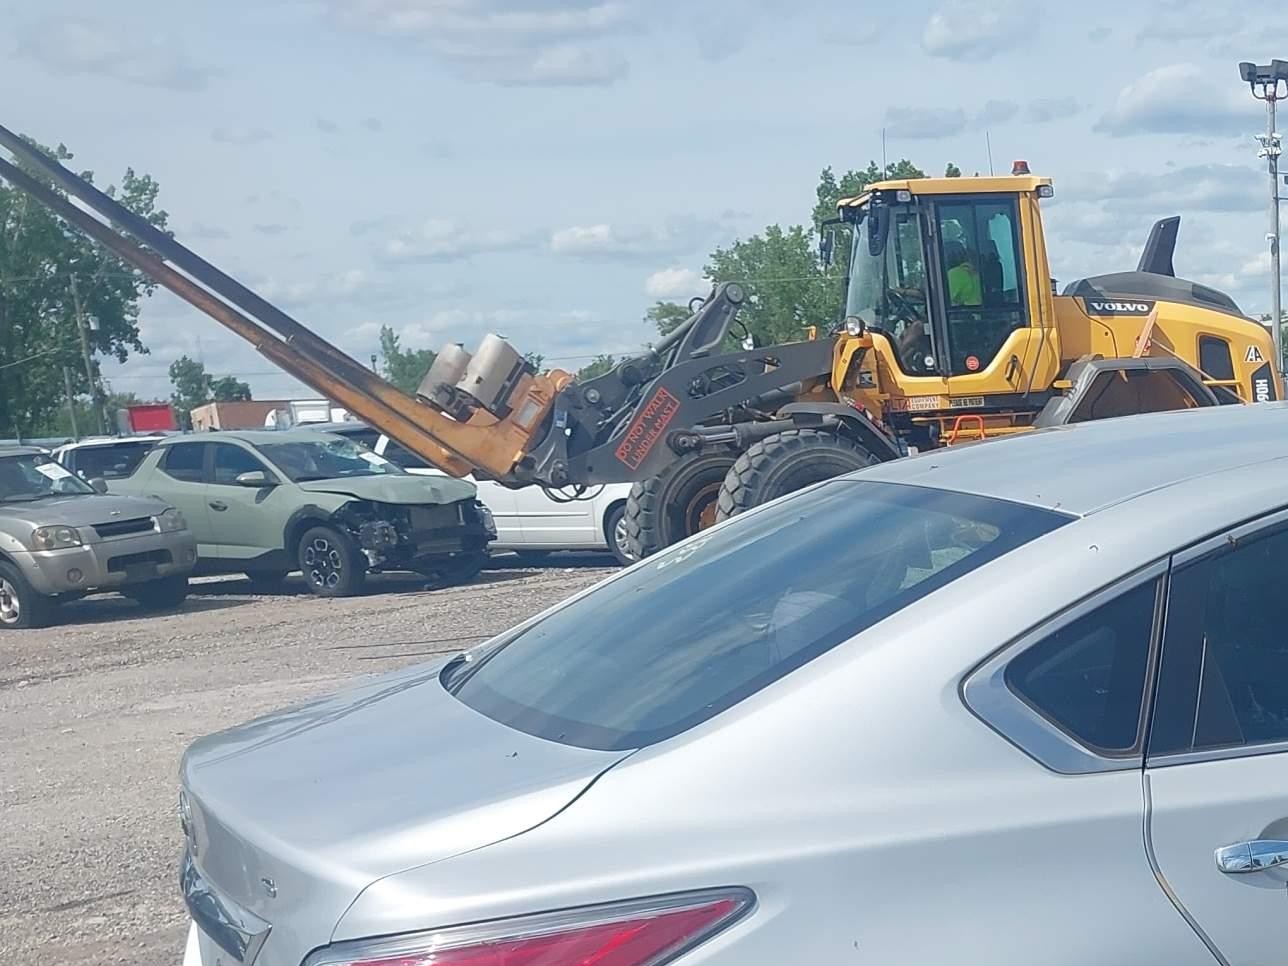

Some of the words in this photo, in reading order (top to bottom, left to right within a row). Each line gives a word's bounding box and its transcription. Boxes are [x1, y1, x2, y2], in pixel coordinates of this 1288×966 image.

[1090, 302, 1149, 312] VOLVO
[618, 442, 632, 458] DO
[629, 421, 647, 443] NOT
[643, 390, 668, 420] WALK
[631, 429, 658, 461] UNDER
[654, 402, 677, 429] MAST
